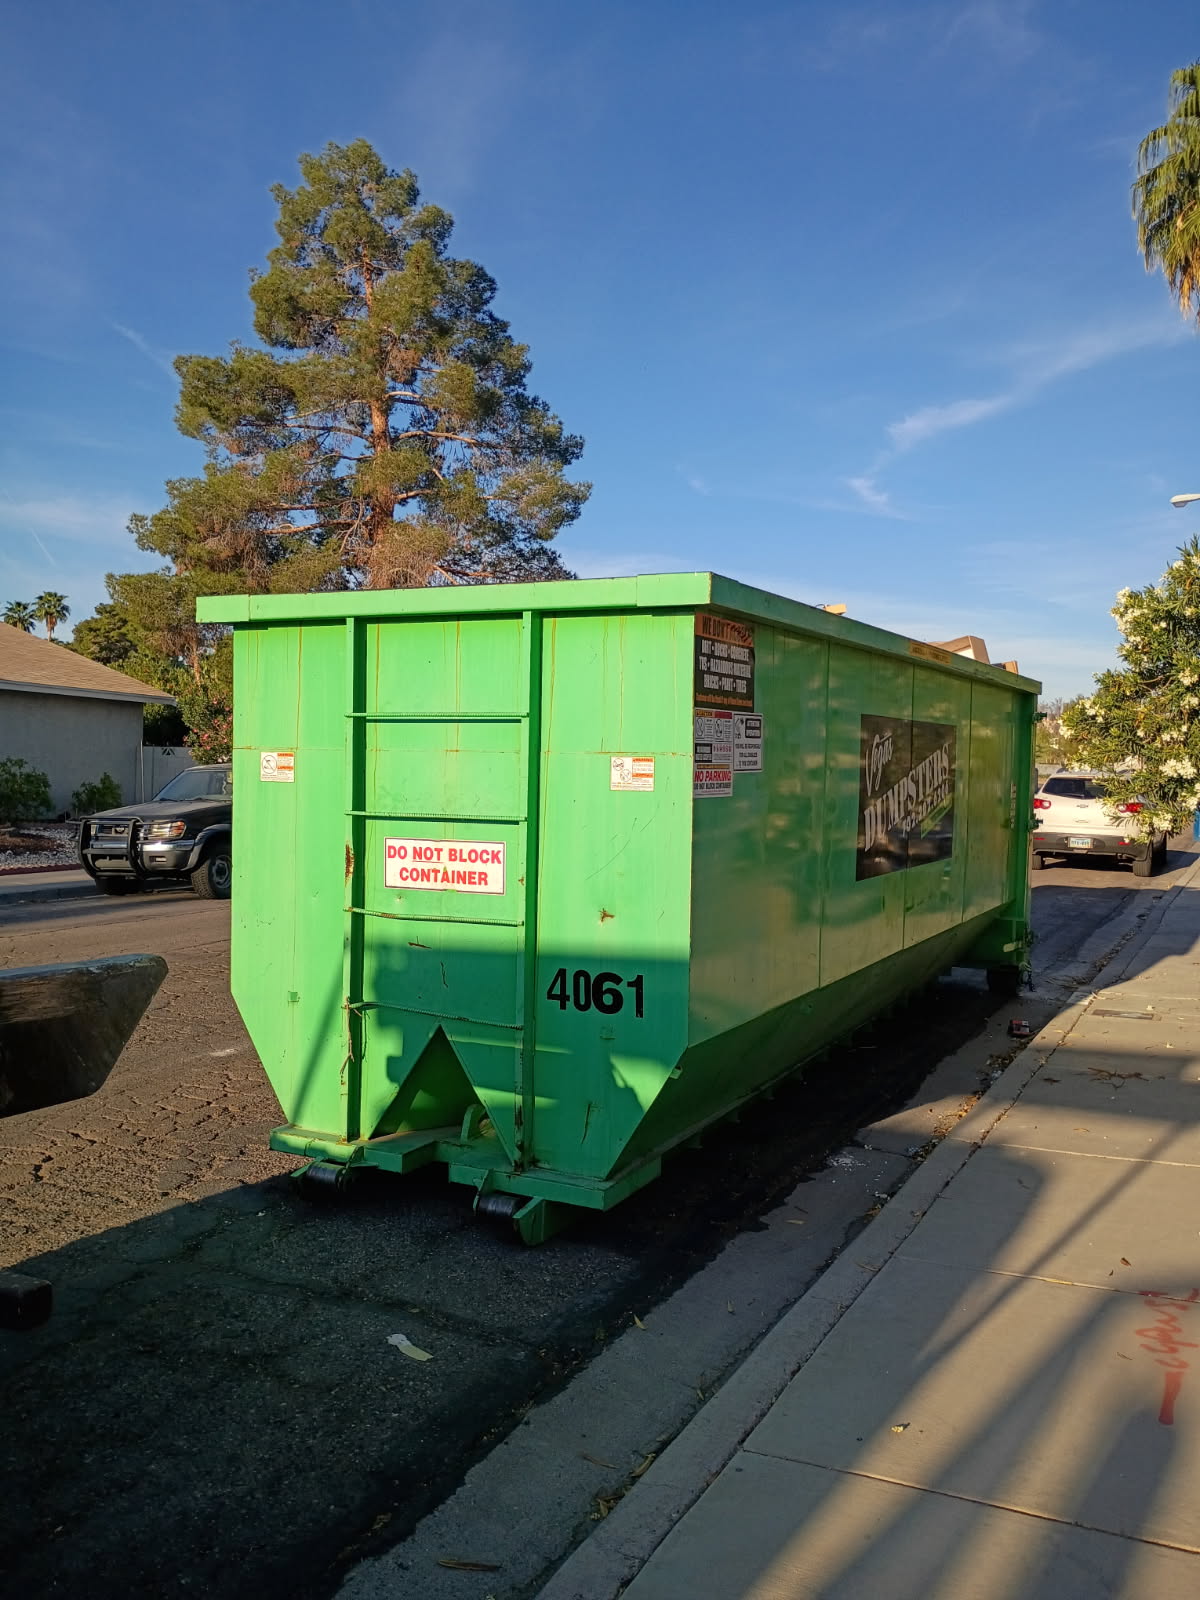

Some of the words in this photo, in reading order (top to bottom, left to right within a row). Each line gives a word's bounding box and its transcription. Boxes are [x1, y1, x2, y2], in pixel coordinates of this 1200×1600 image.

[694, 770, 704, 782] NO
[705, 770, 731, 782] PARKING
[865, 731, 894, 797] Vegas
[864, 742, 951, 853] DUMPSTERS
[387, 845, 408, 860] DO
[412, 846, 444, 862] NOT
[448, 848, 502, 864] BLOCK
[399, 866, 488, 886] CONTAINER
[546, 967, 644, 1018] 4061
